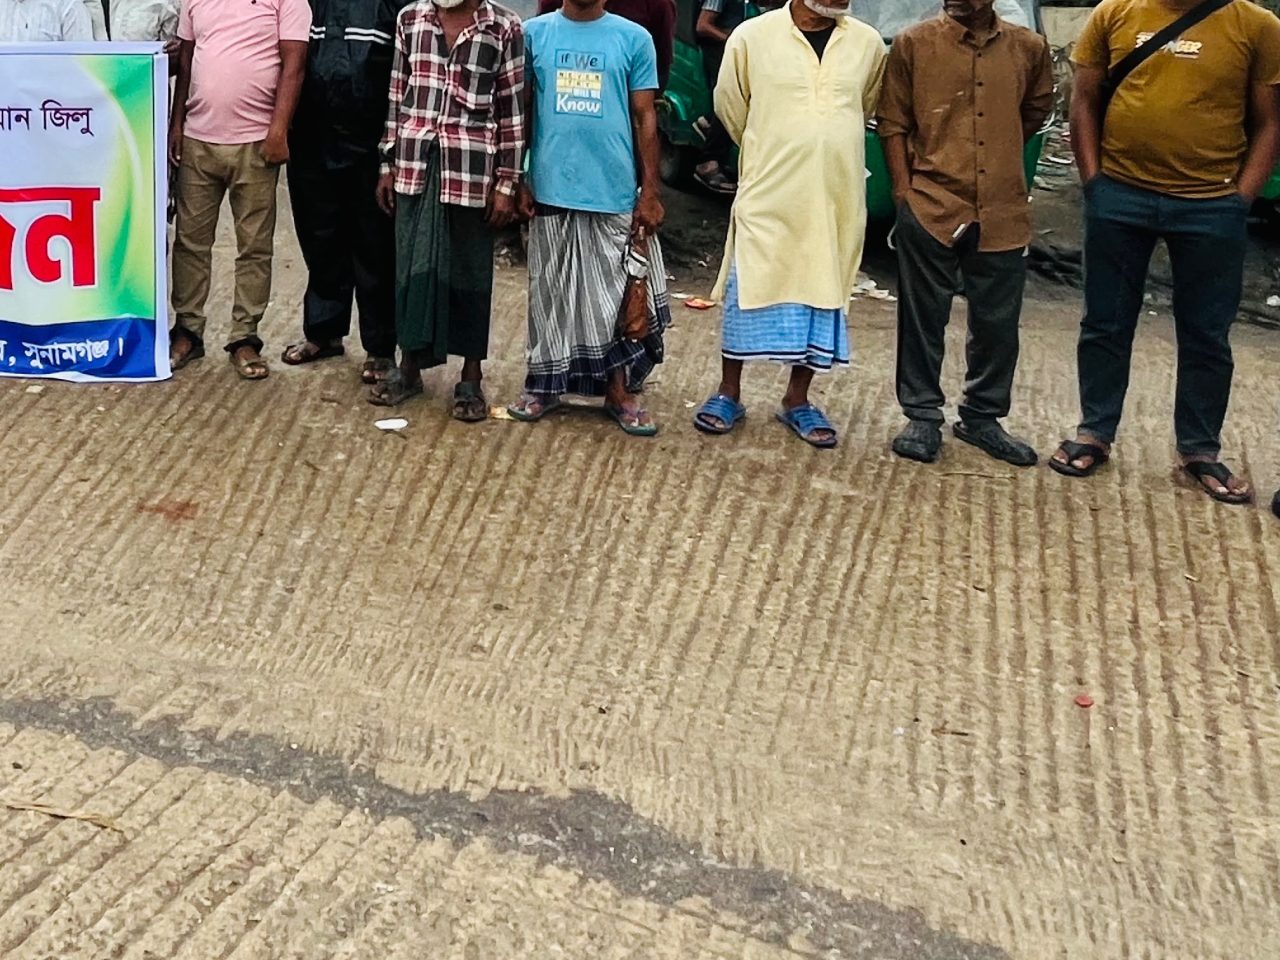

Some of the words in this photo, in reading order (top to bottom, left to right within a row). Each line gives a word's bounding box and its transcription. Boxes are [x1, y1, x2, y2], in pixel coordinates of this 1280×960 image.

[574, 53, 598, 70] We
[556, 93, 600, 113] Know
[40, 99, 95, 137] জিলু
